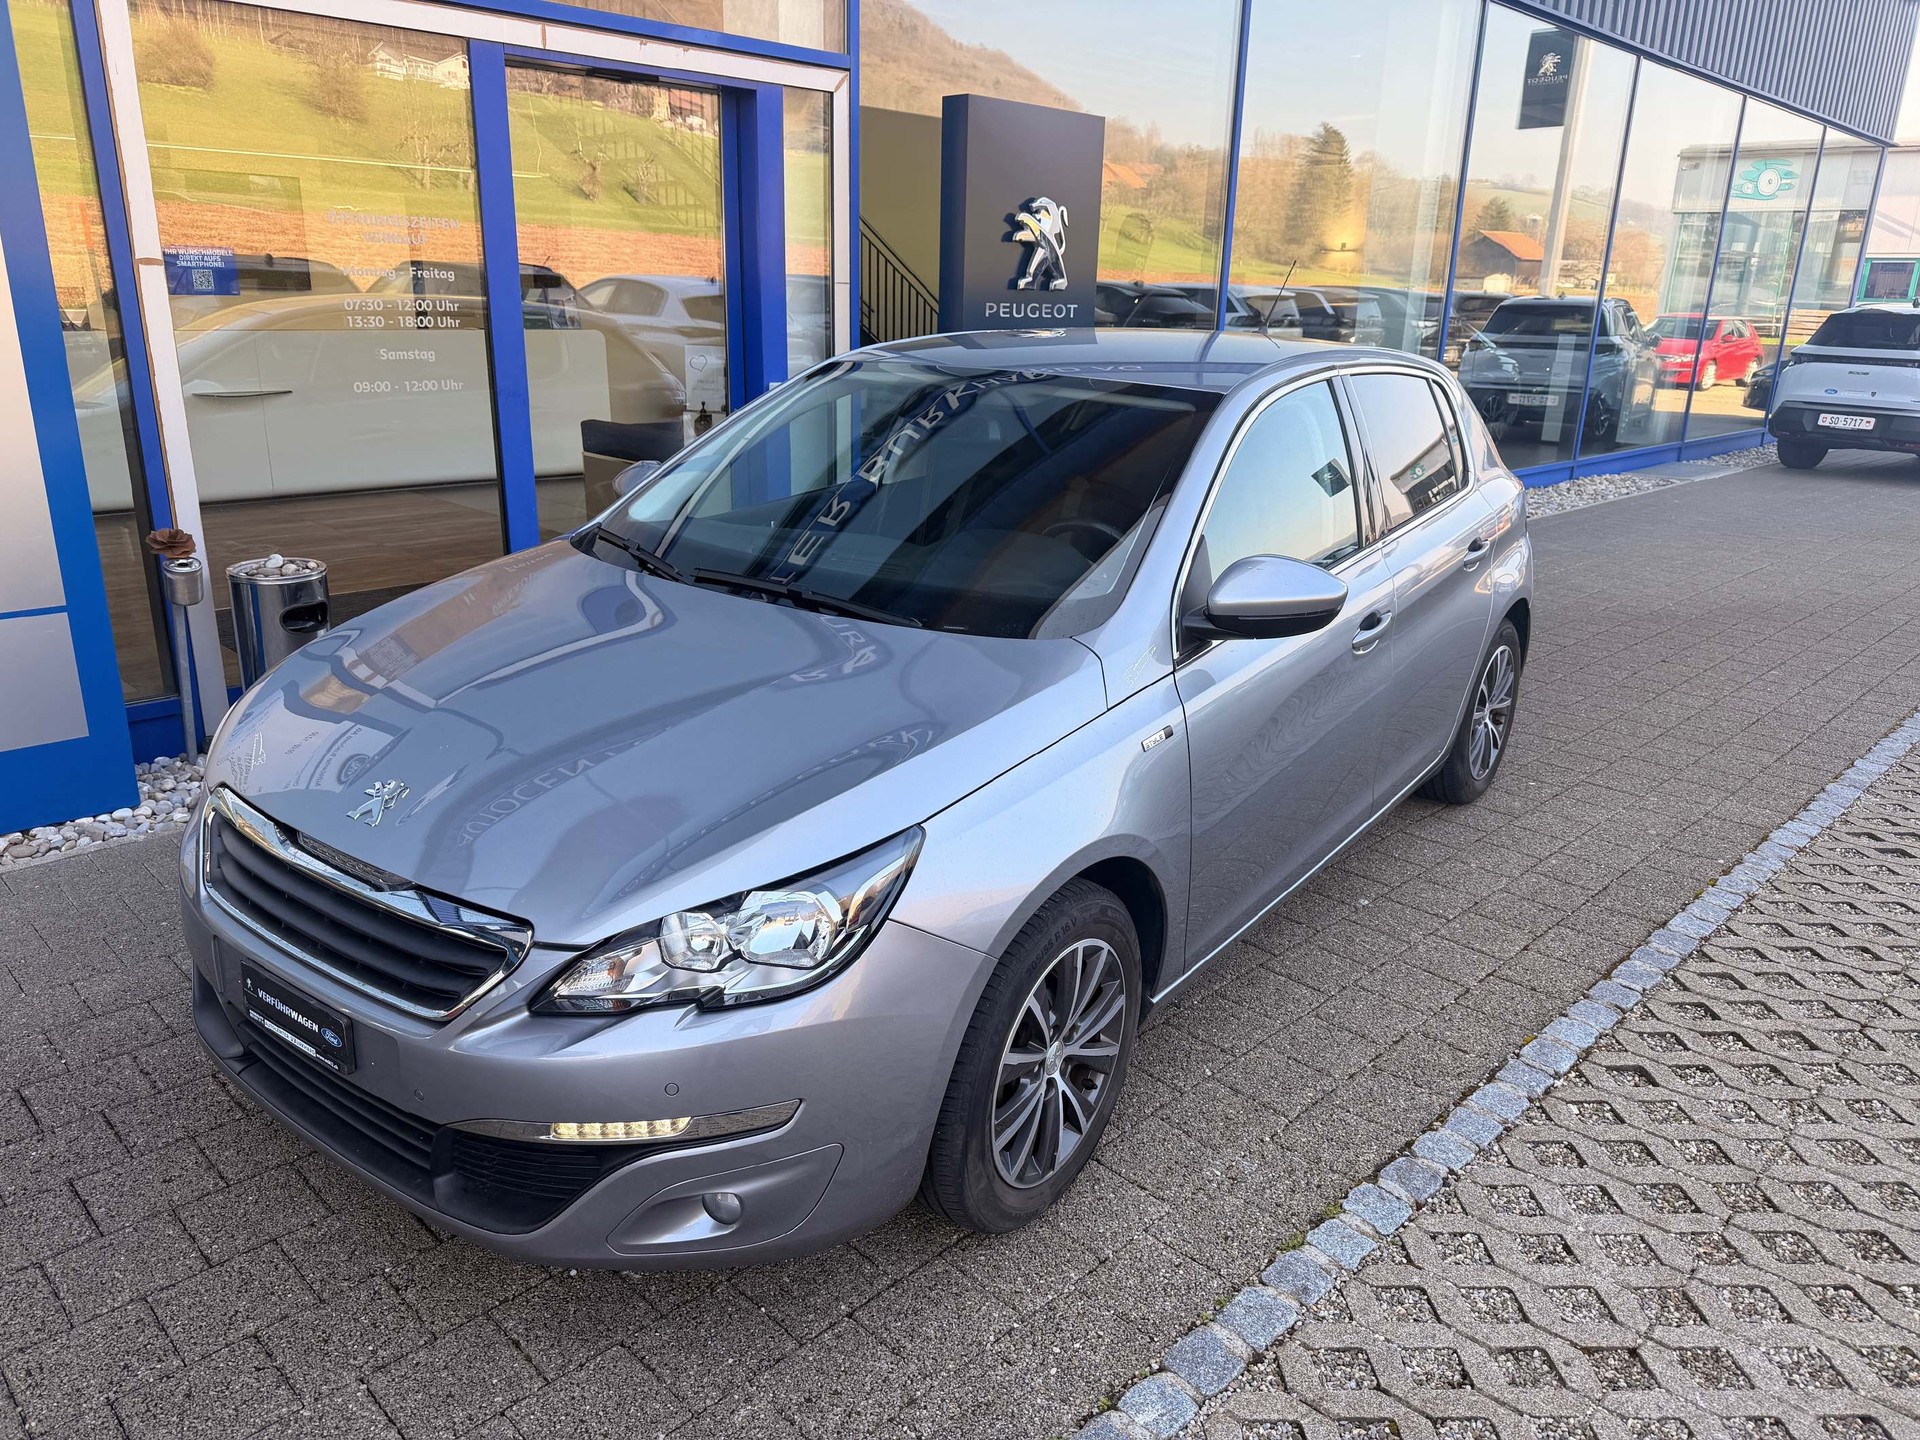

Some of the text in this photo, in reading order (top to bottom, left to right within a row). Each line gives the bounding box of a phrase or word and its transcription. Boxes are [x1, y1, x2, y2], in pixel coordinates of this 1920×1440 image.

[410, 267, 455, 281] Freitag
[344, 300, 383, 311] 07:30
[397, 300, 433, 311] 12:00
[436, 300, 459, 311] Uhr
[985, 302, 1078, 318] PEUGEOT
[346, 316, 385, 327] 13:30
[398, 316, 434, 327] 18:00
[437, 316, 460, 327] Uhr
[380, 349, 435, 361] Samstag
[353, 381, 391, 393] 09:00
[404, 380, 438, 392] 12:00
[441, 380, 464, 390] Uhr
[257, 987, 319, 1032] VERFÜHRWAGEN
